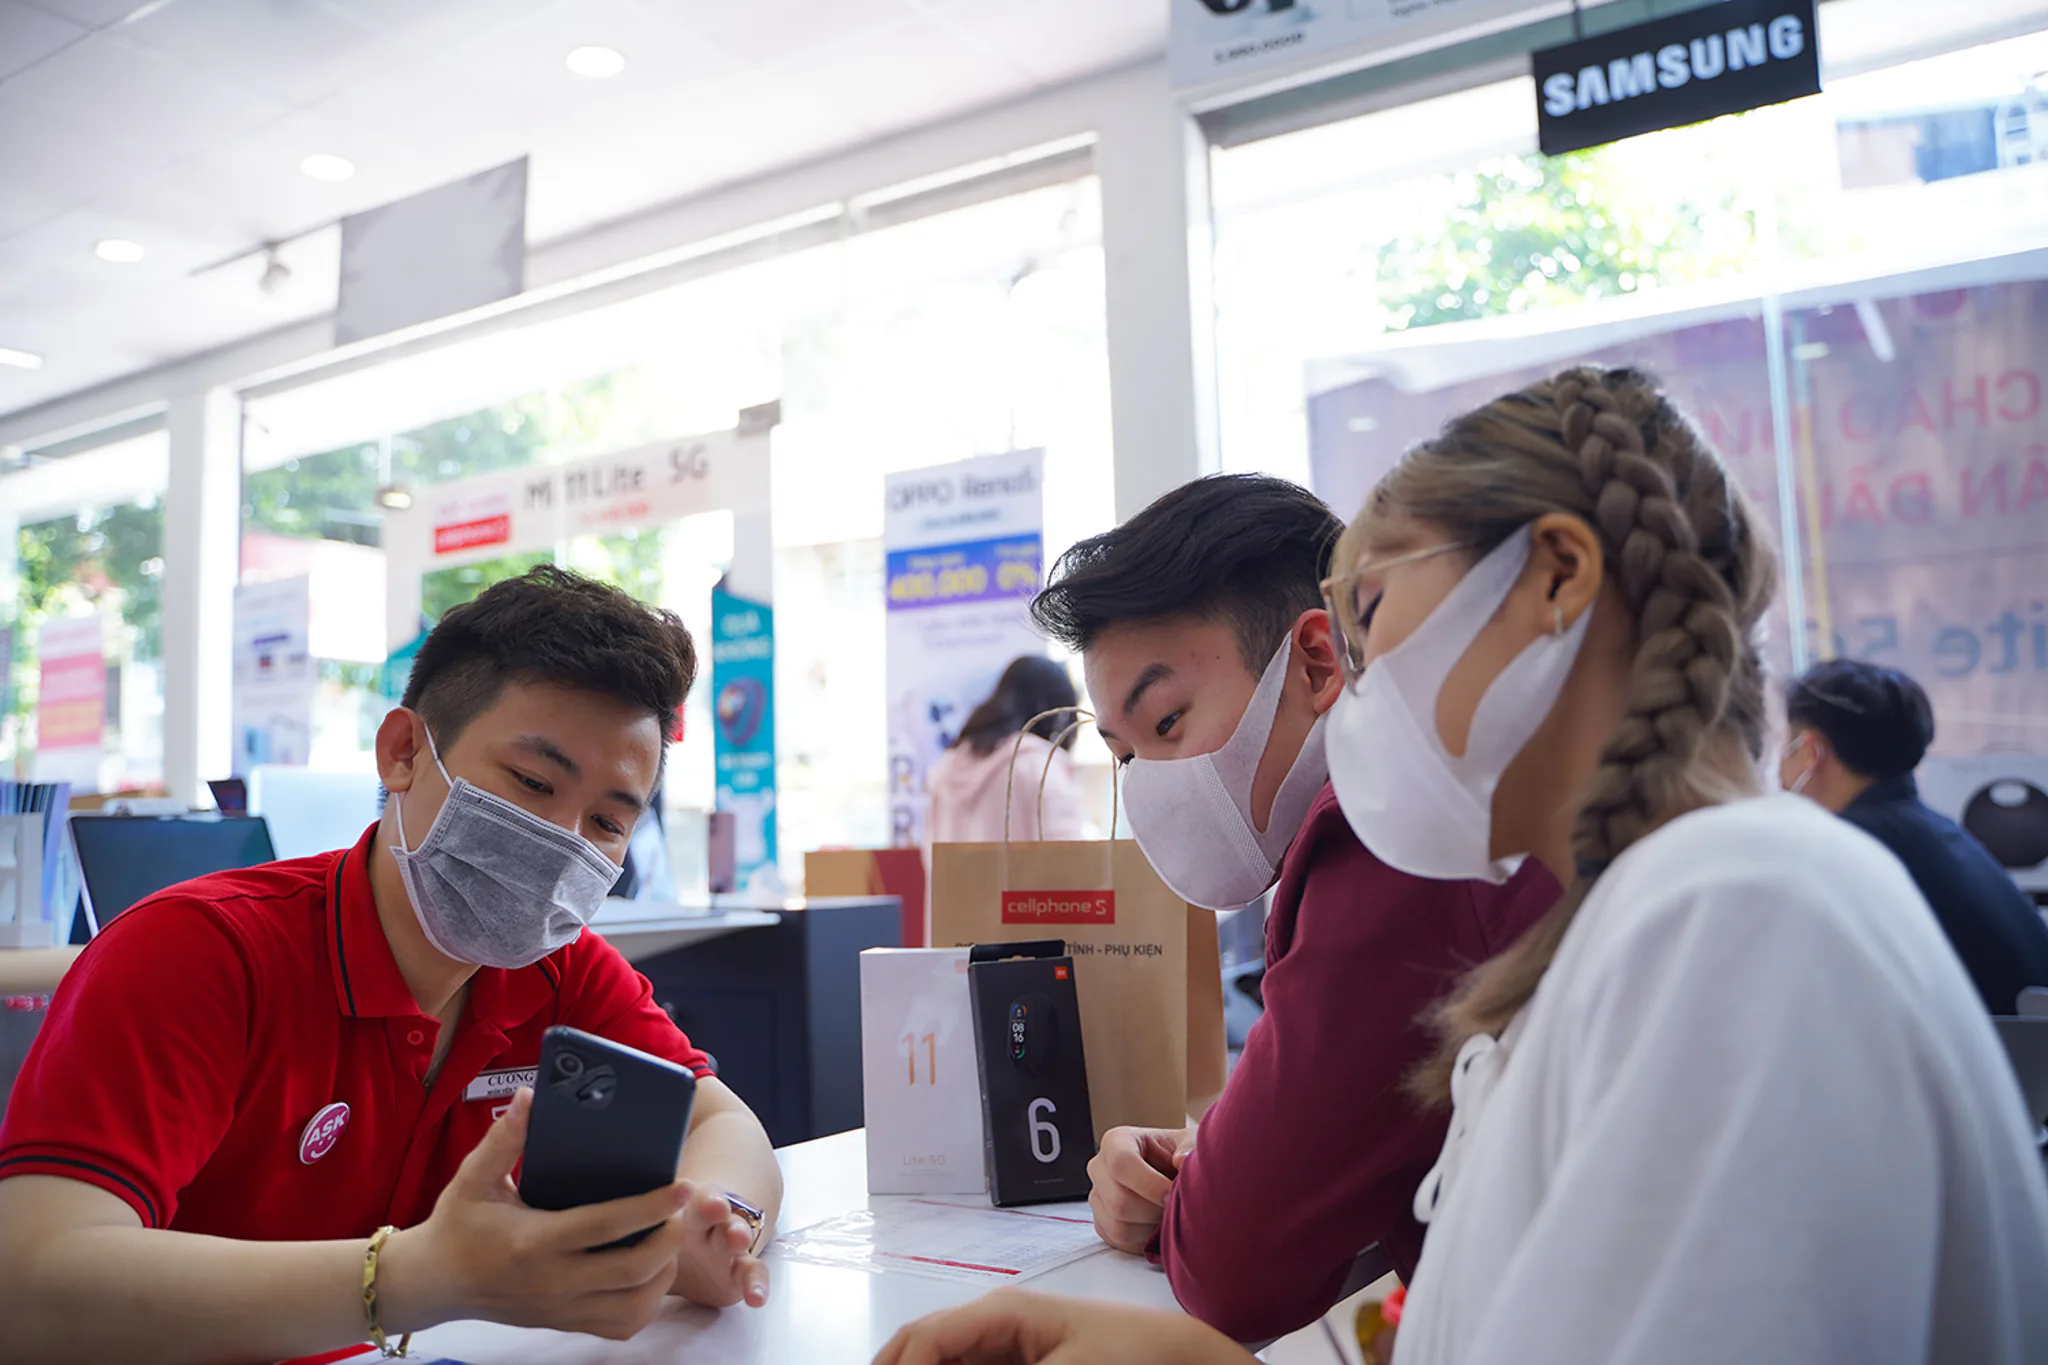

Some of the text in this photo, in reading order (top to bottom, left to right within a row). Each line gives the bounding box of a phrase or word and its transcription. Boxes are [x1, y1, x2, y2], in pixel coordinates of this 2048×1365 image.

[1543, 14, 1804, 117] SAMSUNG
[670, 444, 709, 483] 5G
[1007, 898, 1092, 918] cellphone
[1012, 1022, 1025, 1033] 08
[1013, 1032, 1025, 1043] 16
[901, 1032, 936, 1086] 11
[308, 1112, 345, 1146] ASK
[1028, 1097, 1062, 1164] 6
[903, 1153, 947, 1167] Lite 5G
